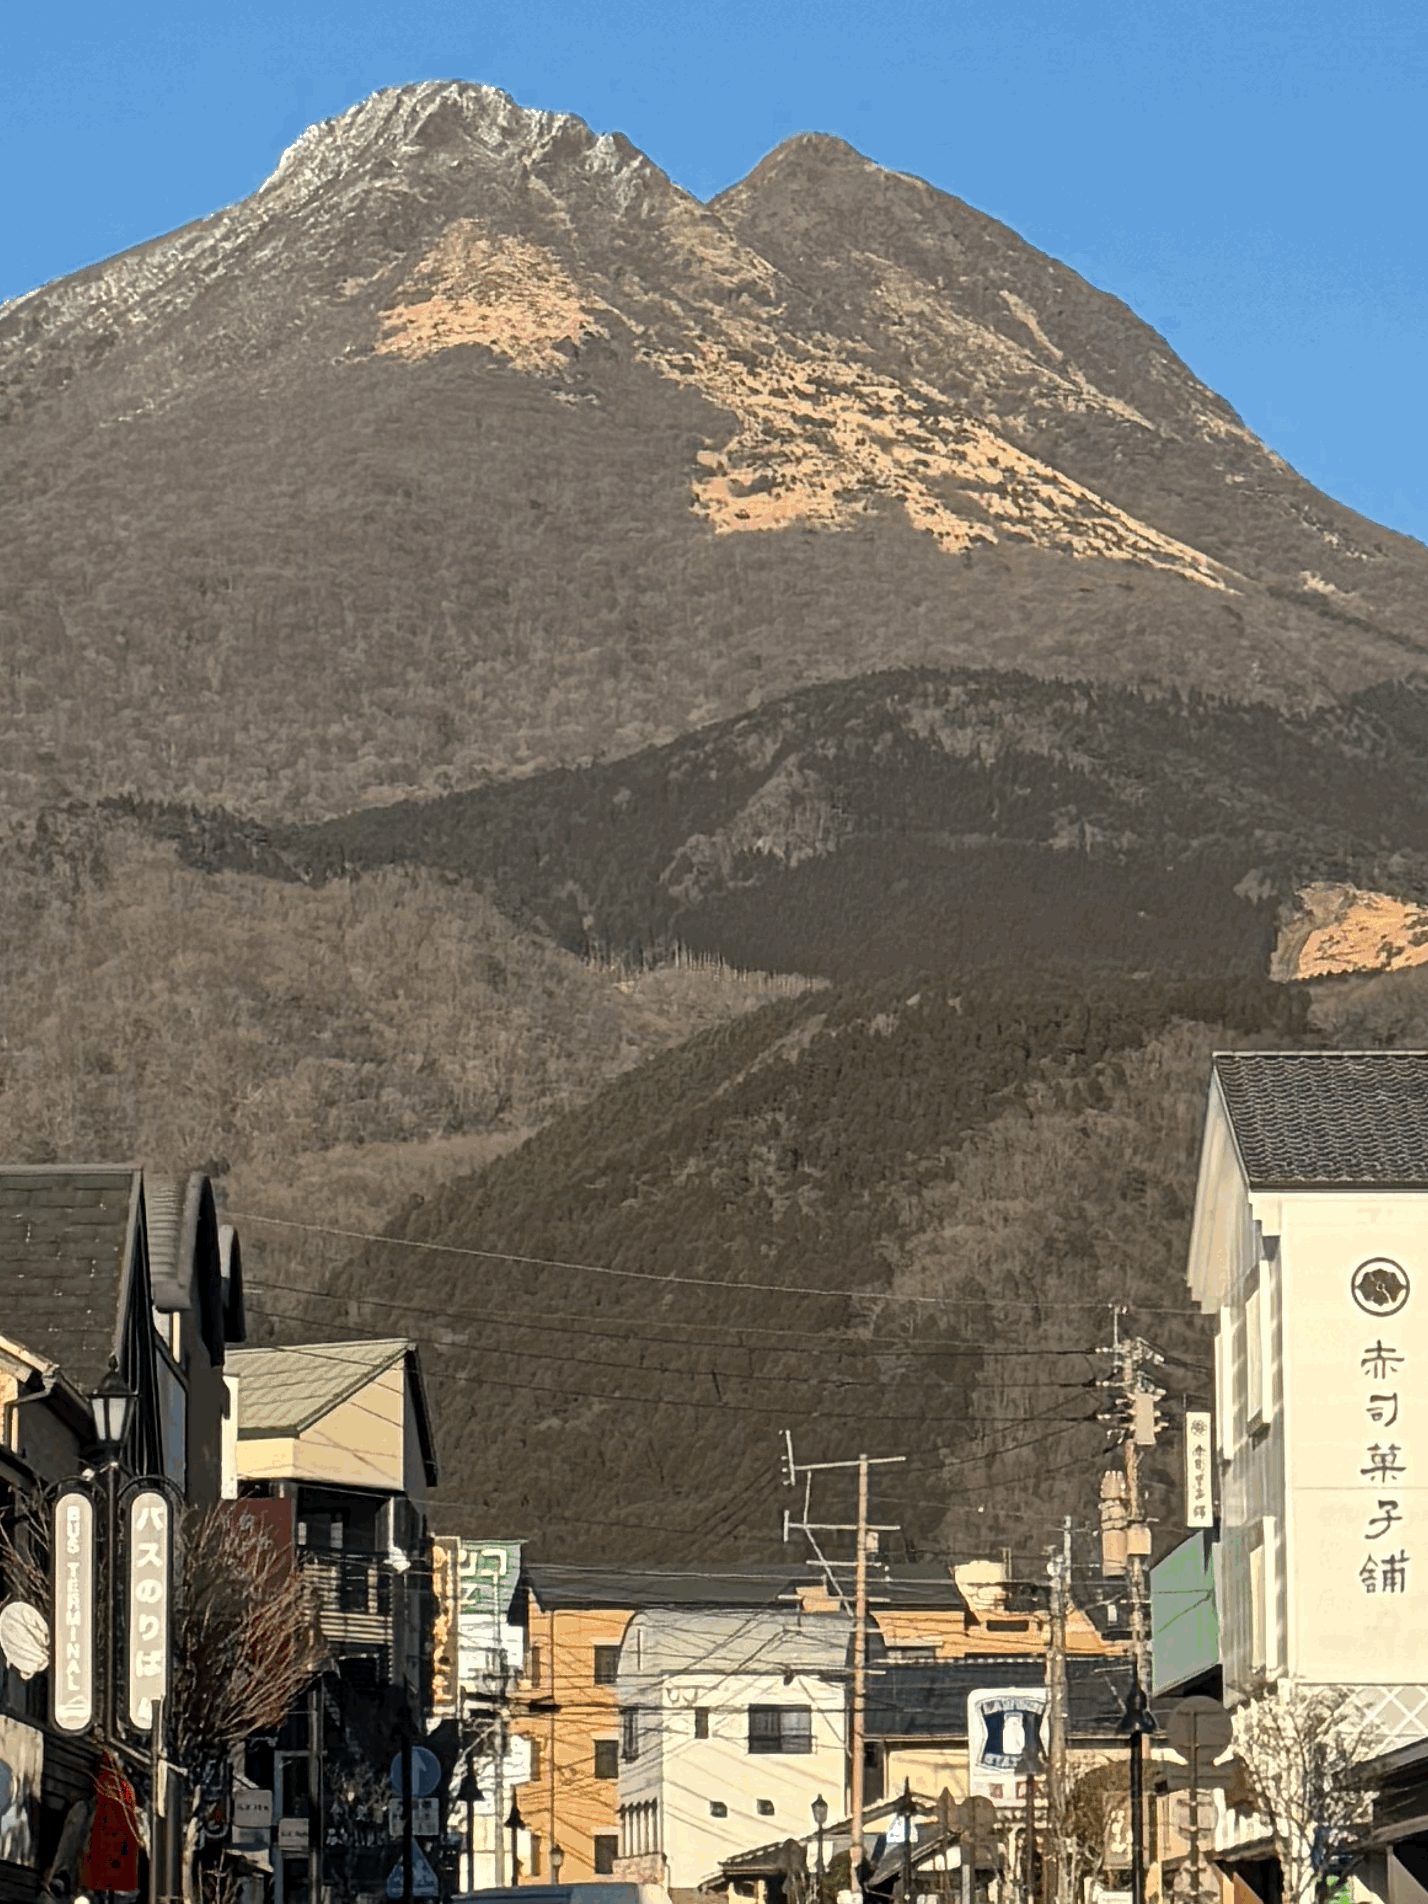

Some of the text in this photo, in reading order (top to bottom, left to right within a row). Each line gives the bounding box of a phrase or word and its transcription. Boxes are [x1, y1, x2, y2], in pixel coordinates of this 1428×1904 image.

[1359, 1339, 1411, 1593] 赤司菓子舗
[66, 1505, 81, 1691] BUS TERMINAL
[134, 1507, 164, 1678] バスのりば
